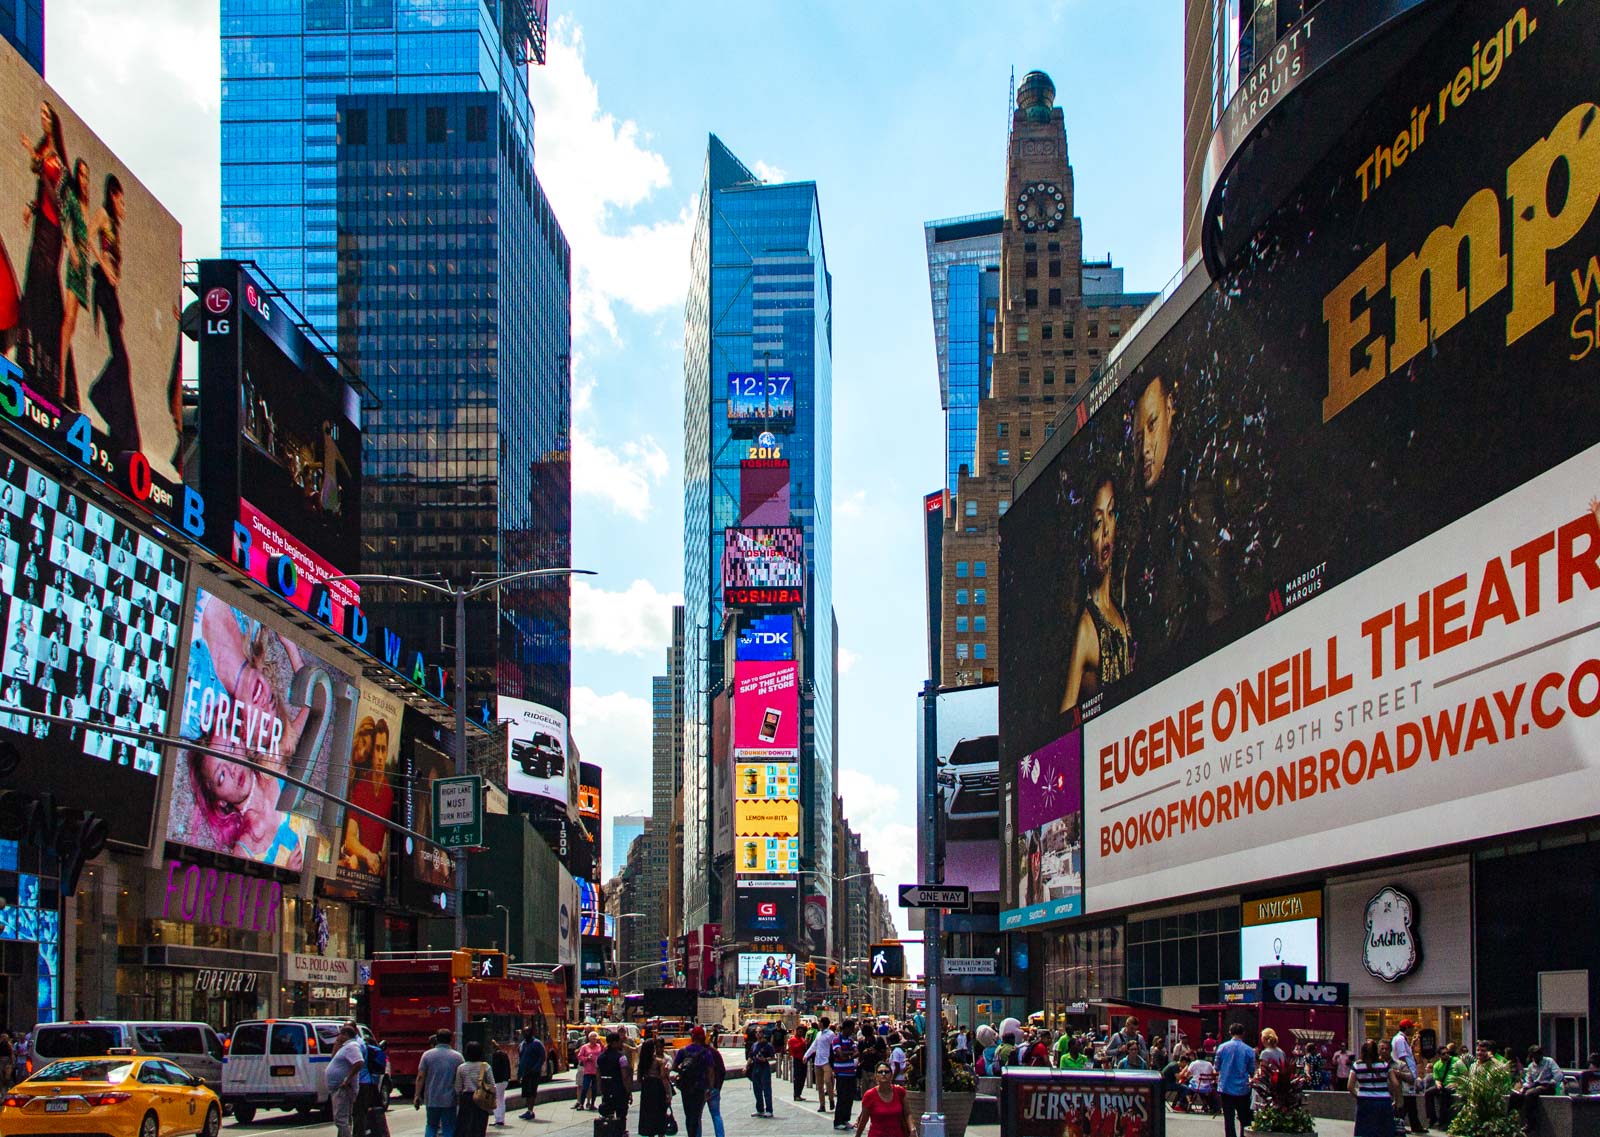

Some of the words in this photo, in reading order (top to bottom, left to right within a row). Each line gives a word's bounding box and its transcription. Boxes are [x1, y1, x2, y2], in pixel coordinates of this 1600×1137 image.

[1231, 18, 1315, 119] MARRIOTT
[1231, 56, 1303, 142] MARQUIS
[1355, 102, 1431, 202] Their
[1439, 7, 1537, 125] reign.
[257, 296, 270, 321] LG
[207, 320, 230, 334] LG
[1089, 358, 1123, 400] MARRIOTT
[1089, 378, 1119, 417] MARQUIS
[24, 396, 50, 428] Tue
[741, 460, 788, 469] TOSHIBA
[750, 447, 780, 459] 2016
[253, 515, 271, 538] Since
[272, 531, 284, 547] the
[1286, 561, 1327, 592] MARRIOTT
[726, 589, 801, 604] TOSHIBA
[1286, 578, 1323, 607] MARQUIS
[752, 632, 788, 644] TDK
[740, 683, 758, 694] SKIP
[759, 678, 775, 688] THE
[776, 672, 794, 684] LINE
[758, 686, 767, 695] IN
[768, 680, 794, 693] STORE
[185, 680, 283, 761] FOREVER
[523, 711, 562, 728] RIDGELINE
[1099, 699, 1205, 792] EUGENE
[1211, 635, 1353, 742] O'NEILL
[1185, 761, 1212, 788] 230
[1219, 739, 1264, 776] WEST
[1275, 712, 1323, 754] 49TH
[1334, 679, 1424, 733] STREET
[447, 799, 465, 807] MUST
[440, 835, 447, 844] W
[450, 834, 460, 843] 45
[464, 834, 473, 842] ST
[163, 861, 282, 933] FOREVER
[920, 891, 939, 900] ONE
[942, 892, 960, 900] WAY
[1258, 897, 1303, 919] INVICTA
[295, 957, 308, 970] U.S.
[309, 959, 329, 972] POLO
[195, 969, 244, 992] FOREVER
[245, 973, 257, 992] 21
[1294, 985, 1338, 1001] NYC
[1023, 1092, 1094, 1121] JERSEY
